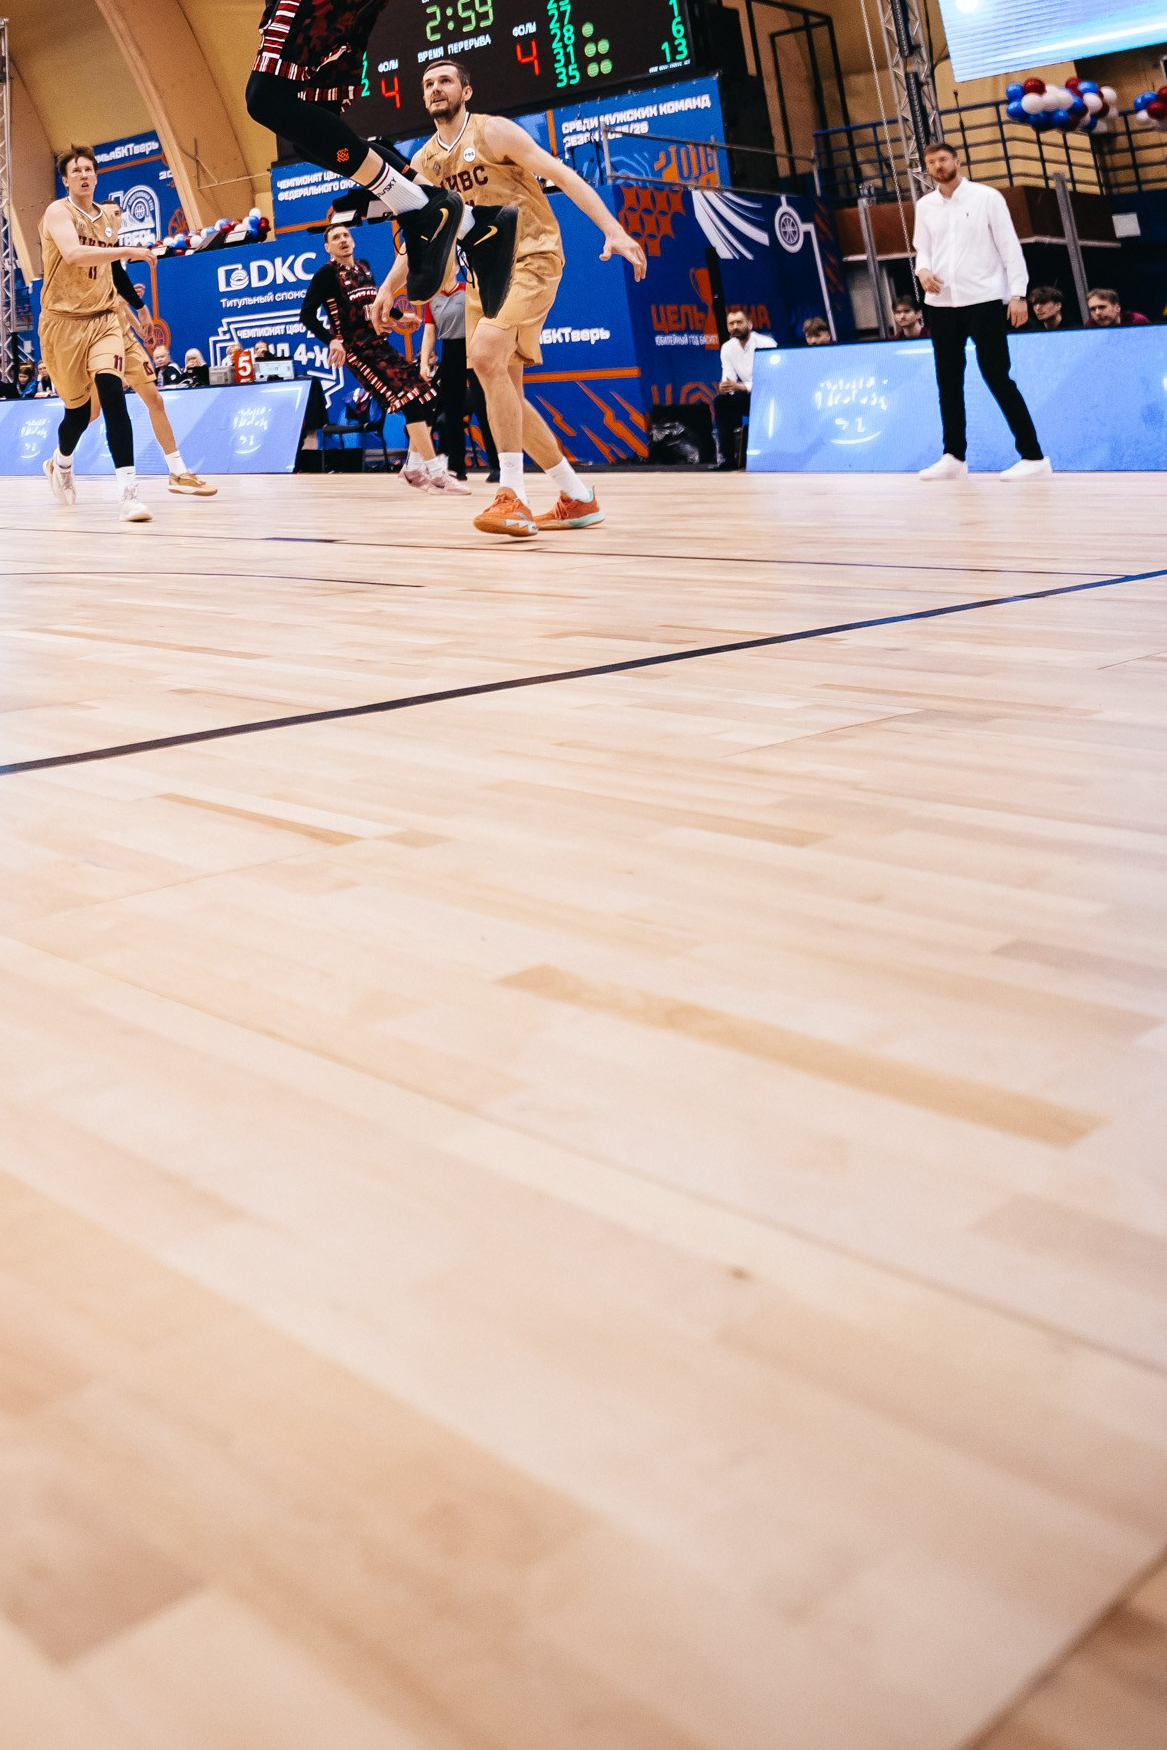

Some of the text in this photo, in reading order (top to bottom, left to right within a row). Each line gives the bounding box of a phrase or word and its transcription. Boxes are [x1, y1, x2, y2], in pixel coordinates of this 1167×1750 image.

[548, 4, 571, 29] 27
[512, 21, 537, 37] ФОЛЫ
[551, 24, 575, 48] 28
[417, 34, 492, 63] ВРЕМЯ ПЕРЕРЫВА
[554, 16, 685, 68] 31 6
[377, 58, 399, 73] ФОЛЫ
[516, 39, 539, 76] 4
[556, 37, 688, 88] 35 13
[381, 76, 401, 109] 4
[659, 94, 712, 116] КОМАНД
[277, 173, 323, 190] ЧЕМПИОНАТ
[277, 179, 339, 202] ФЕДЕРАЛЬНОГО
[440, 165, 489, 193] ИВС
[249, 252, 317, 288] DKC
[220, 293, 274, 309] Титульный
[651, 303, 709, 333] ЦЕЛЬ
[237, 325, 286, 340] ЧЕМПИОНАТ
[113, 354, 123, 372] 11
[237, 355, 252, 377] 5
